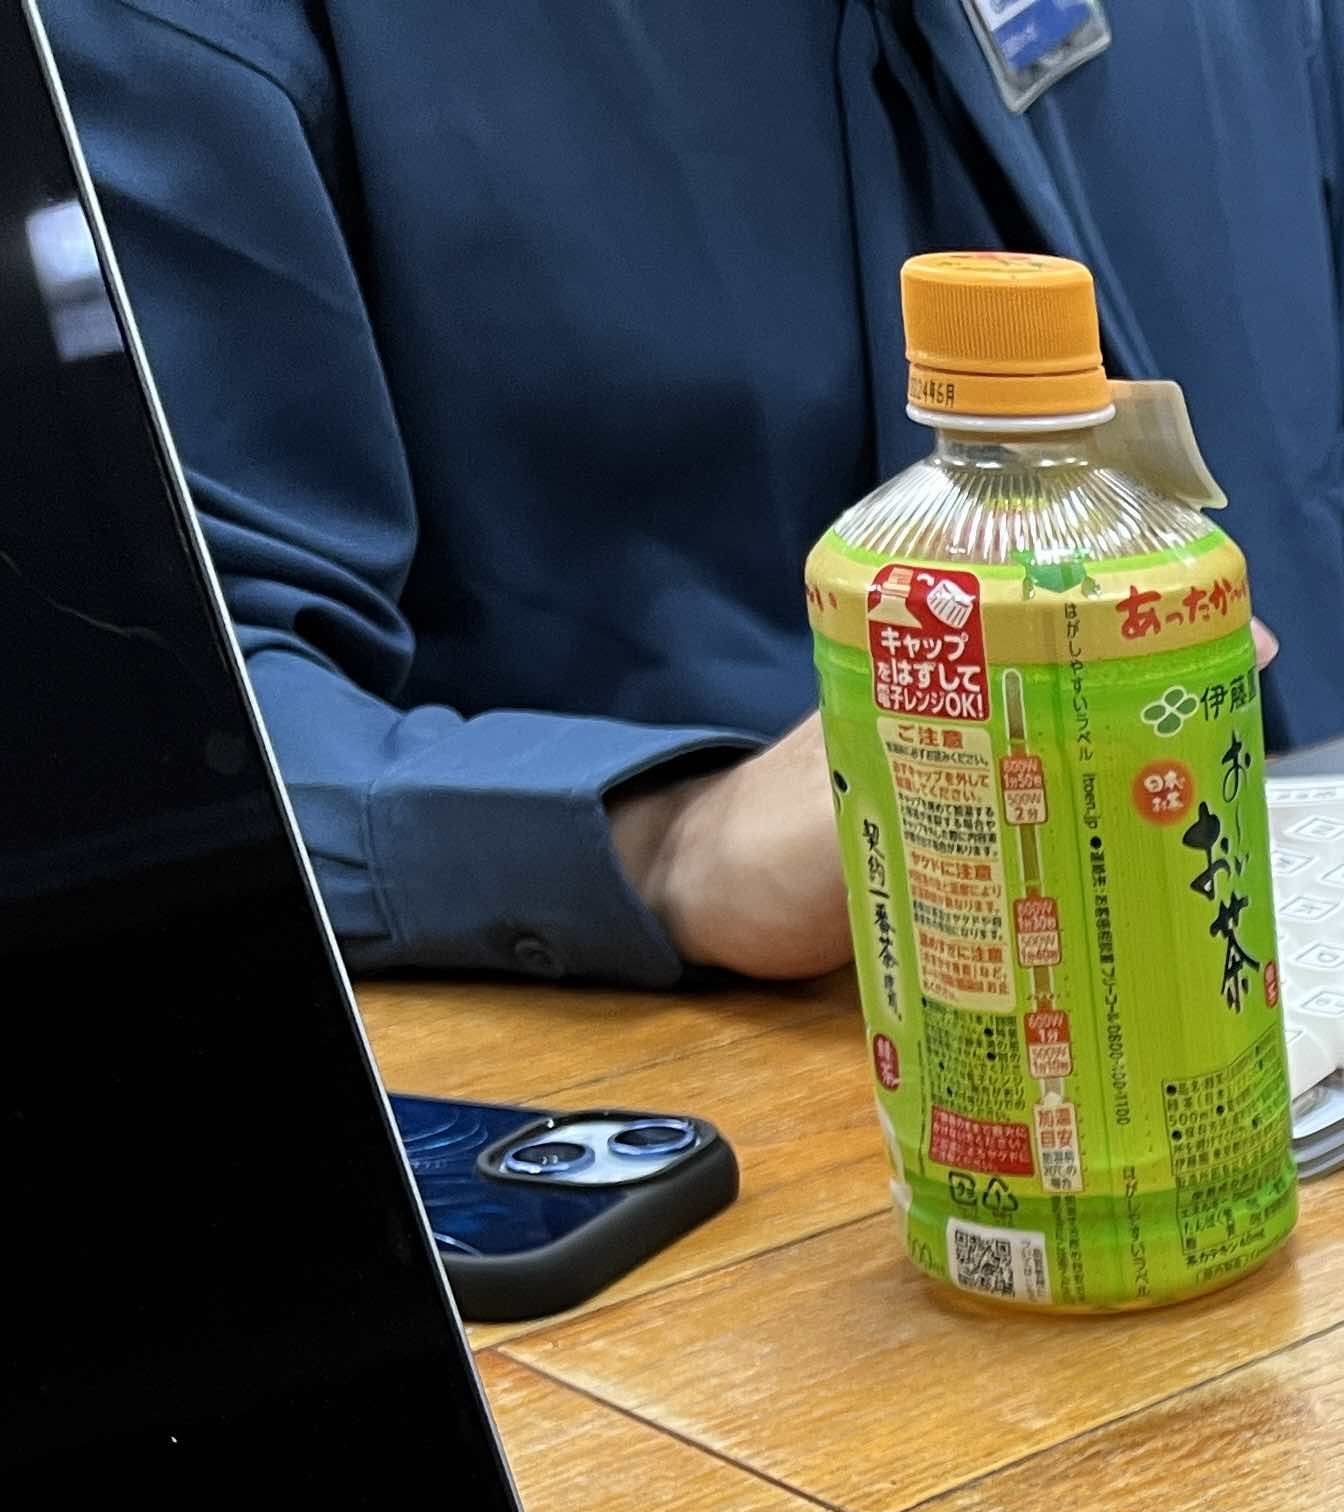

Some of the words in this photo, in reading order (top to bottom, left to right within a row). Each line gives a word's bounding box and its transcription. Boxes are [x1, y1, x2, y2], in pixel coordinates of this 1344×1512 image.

[881, 627, 969, 661] キャップ
[877, 657, 981, 692] をはずして
[877, 683, 984, 718] 電子レンジOK!
[898, 724, 964, 750] ご注意
[1182, 801, 1260, 1014] お茶
